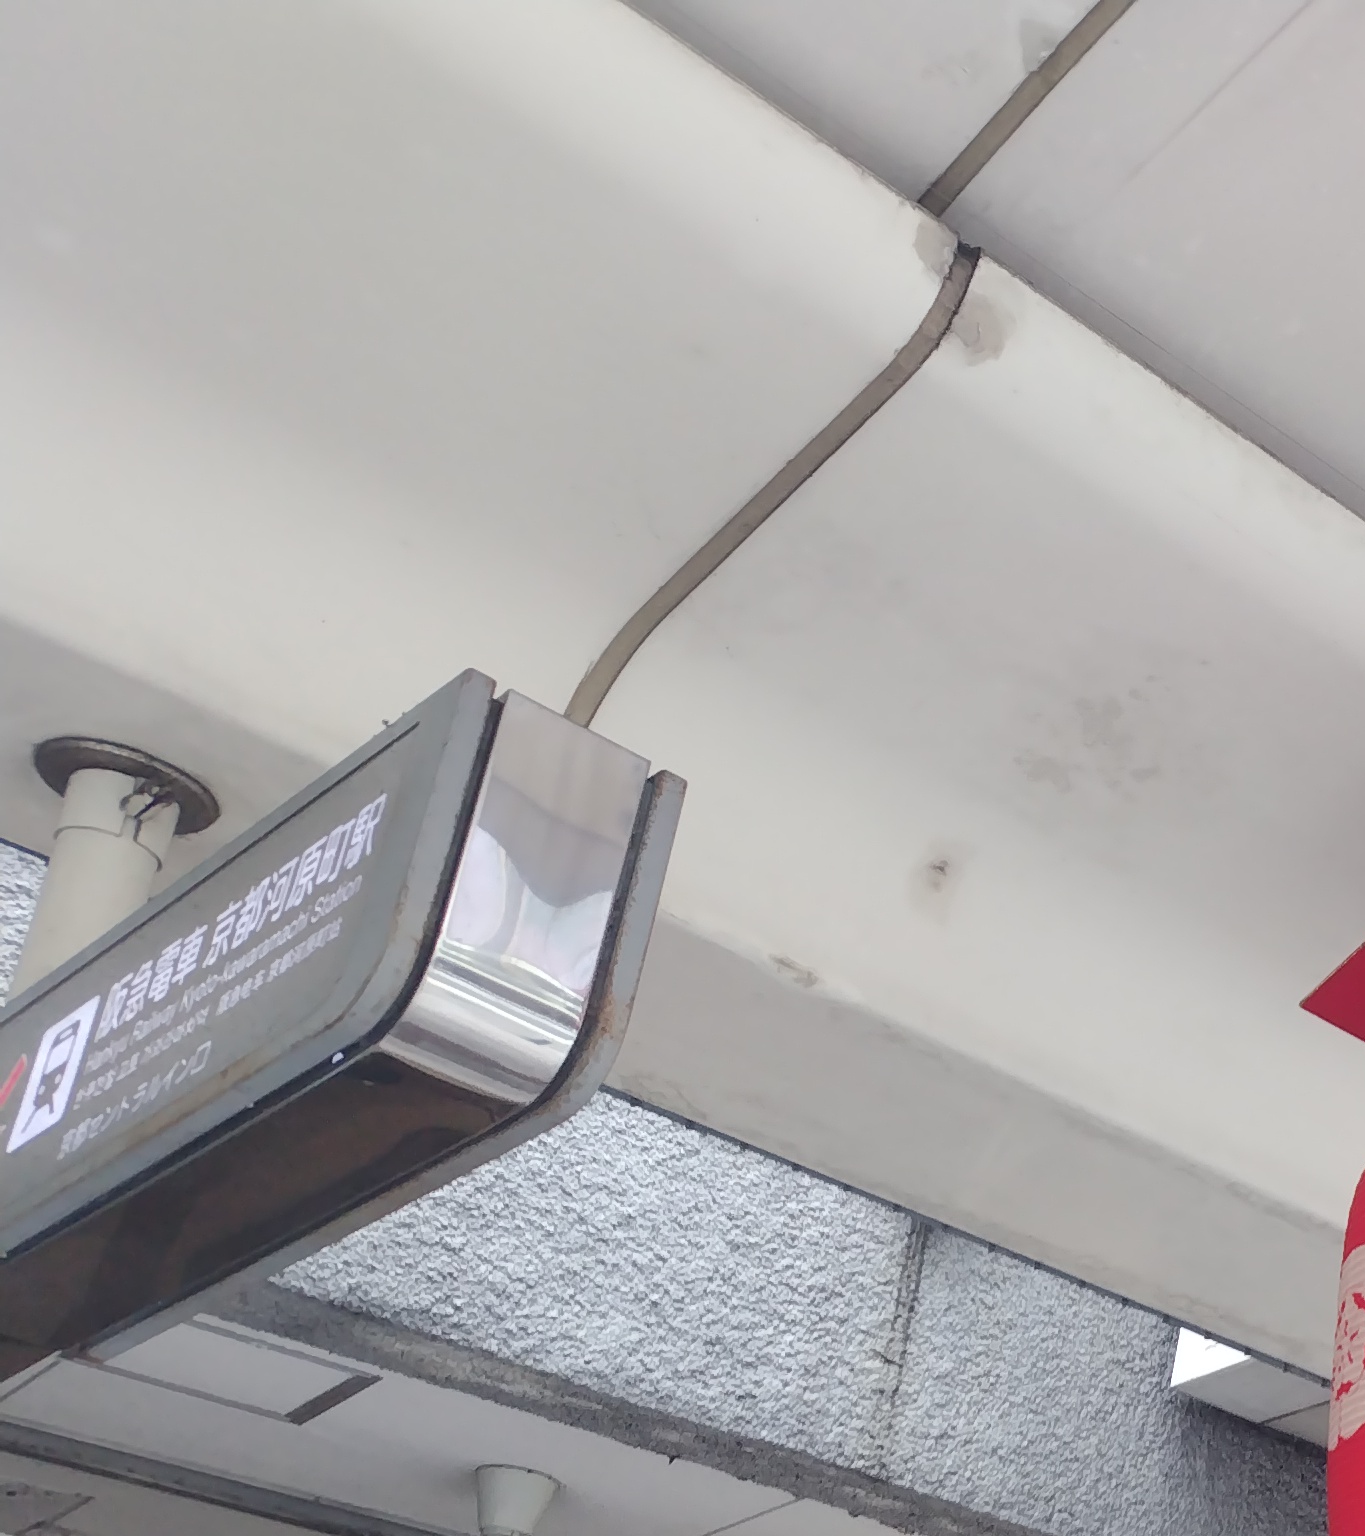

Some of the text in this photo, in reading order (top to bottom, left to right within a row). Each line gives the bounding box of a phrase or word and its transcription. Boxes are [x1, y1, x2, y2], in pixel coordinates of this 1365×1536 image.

[95, 793, 387, 1043] 阪急電車 京都河原町駅
